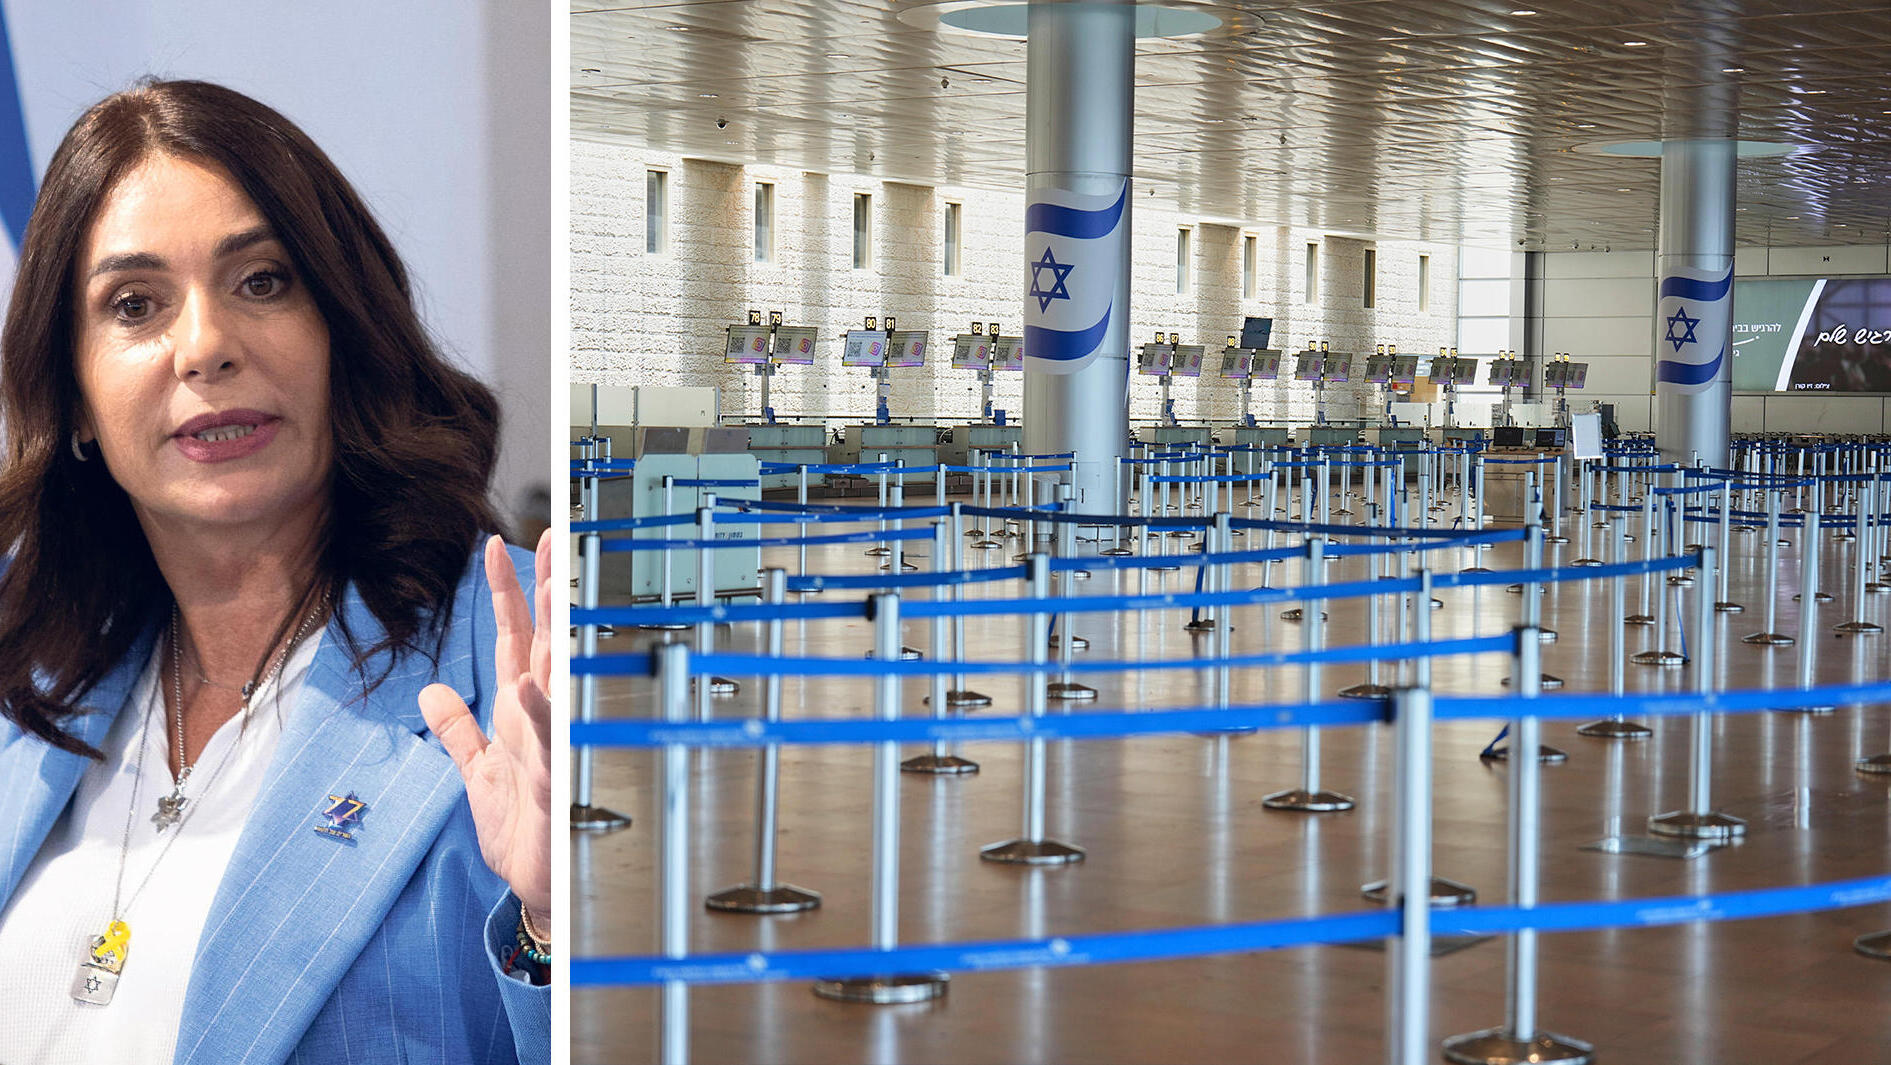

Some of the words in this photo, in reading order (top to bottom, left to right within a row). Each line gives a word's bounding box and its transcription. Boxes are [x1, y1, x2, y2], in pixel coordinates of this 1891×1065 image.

[750, 311, 760, 323] 78
[771, 312, 781, 324] 79
[866, 318, 876, 329] 80
[886, 318, 895, 329] 81
[973, 323, 982, 334] 82
[1751, 322, 1782, 332] להרגיש
[991, 324, 999, 335] 83
[1156, 333, 1164, 343] 86
[1171, 334, 1179, 344] 87
